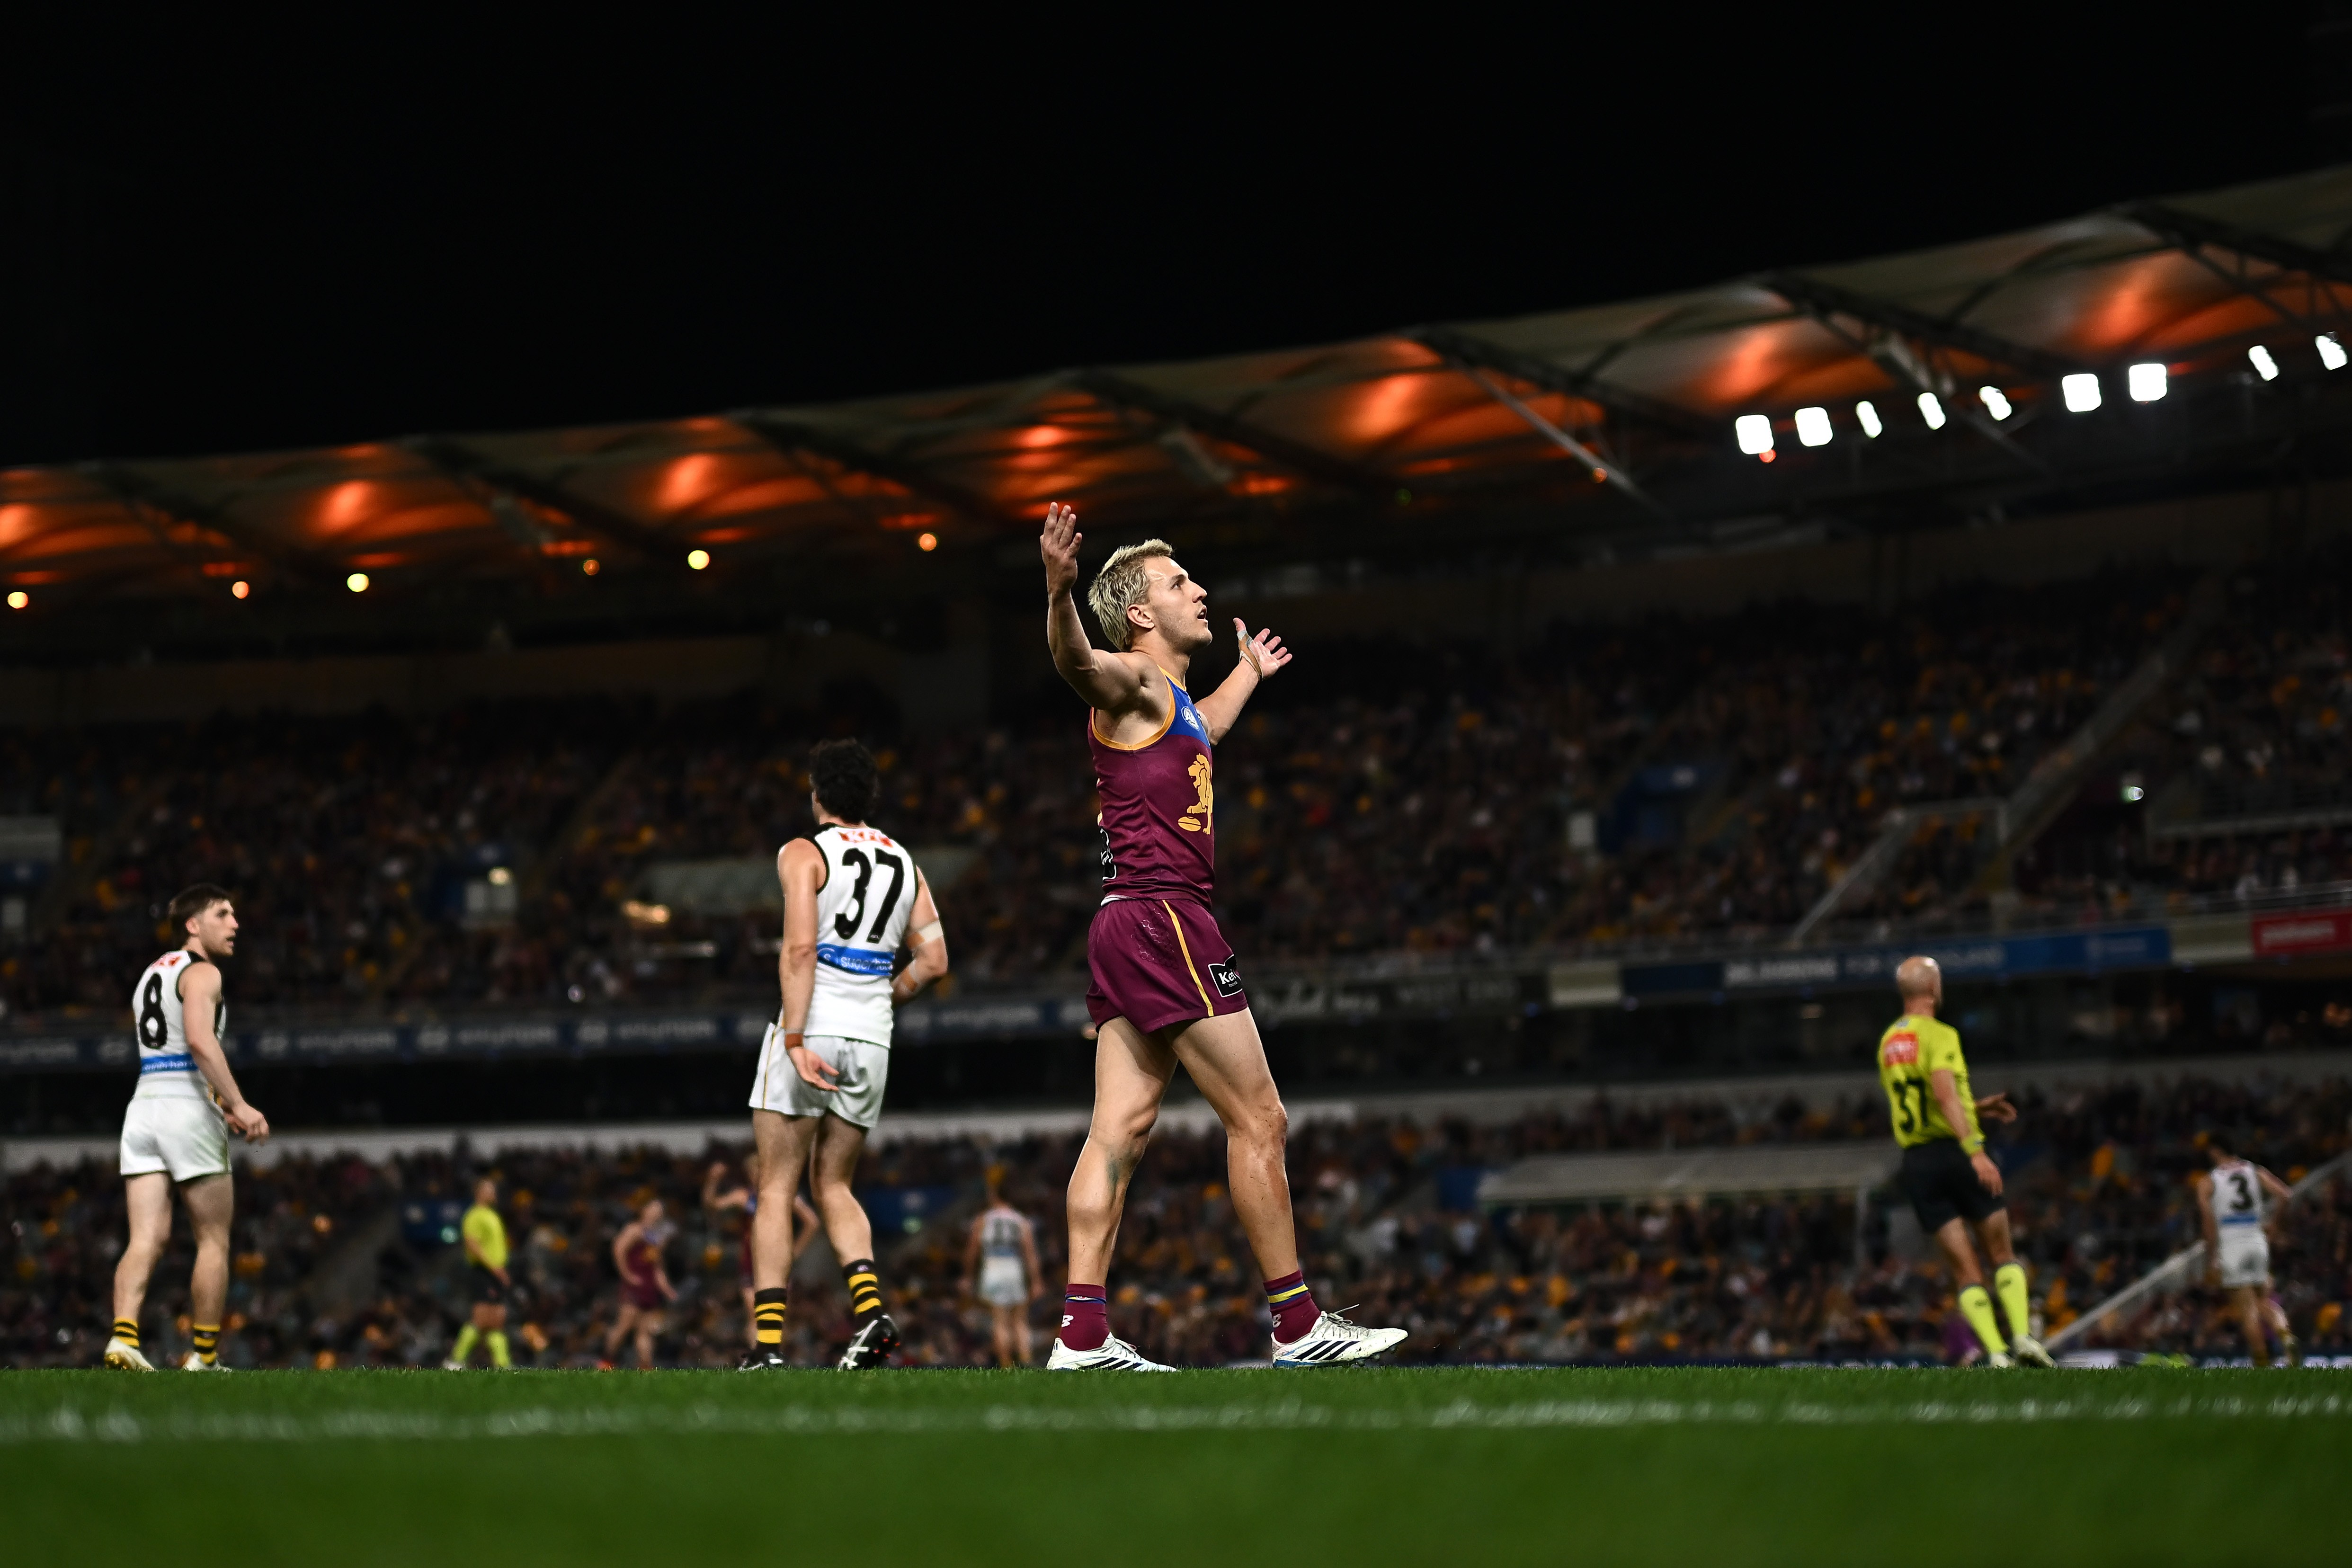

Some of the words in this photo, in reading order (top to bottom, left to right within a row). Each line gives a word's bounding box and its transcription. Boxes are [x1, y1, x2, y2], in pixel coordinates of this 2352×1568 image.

[834, 847, 905, 944] 37
[140, 972, 168, 1049] 8
[2228, 1173, 2254, 1211] 3
